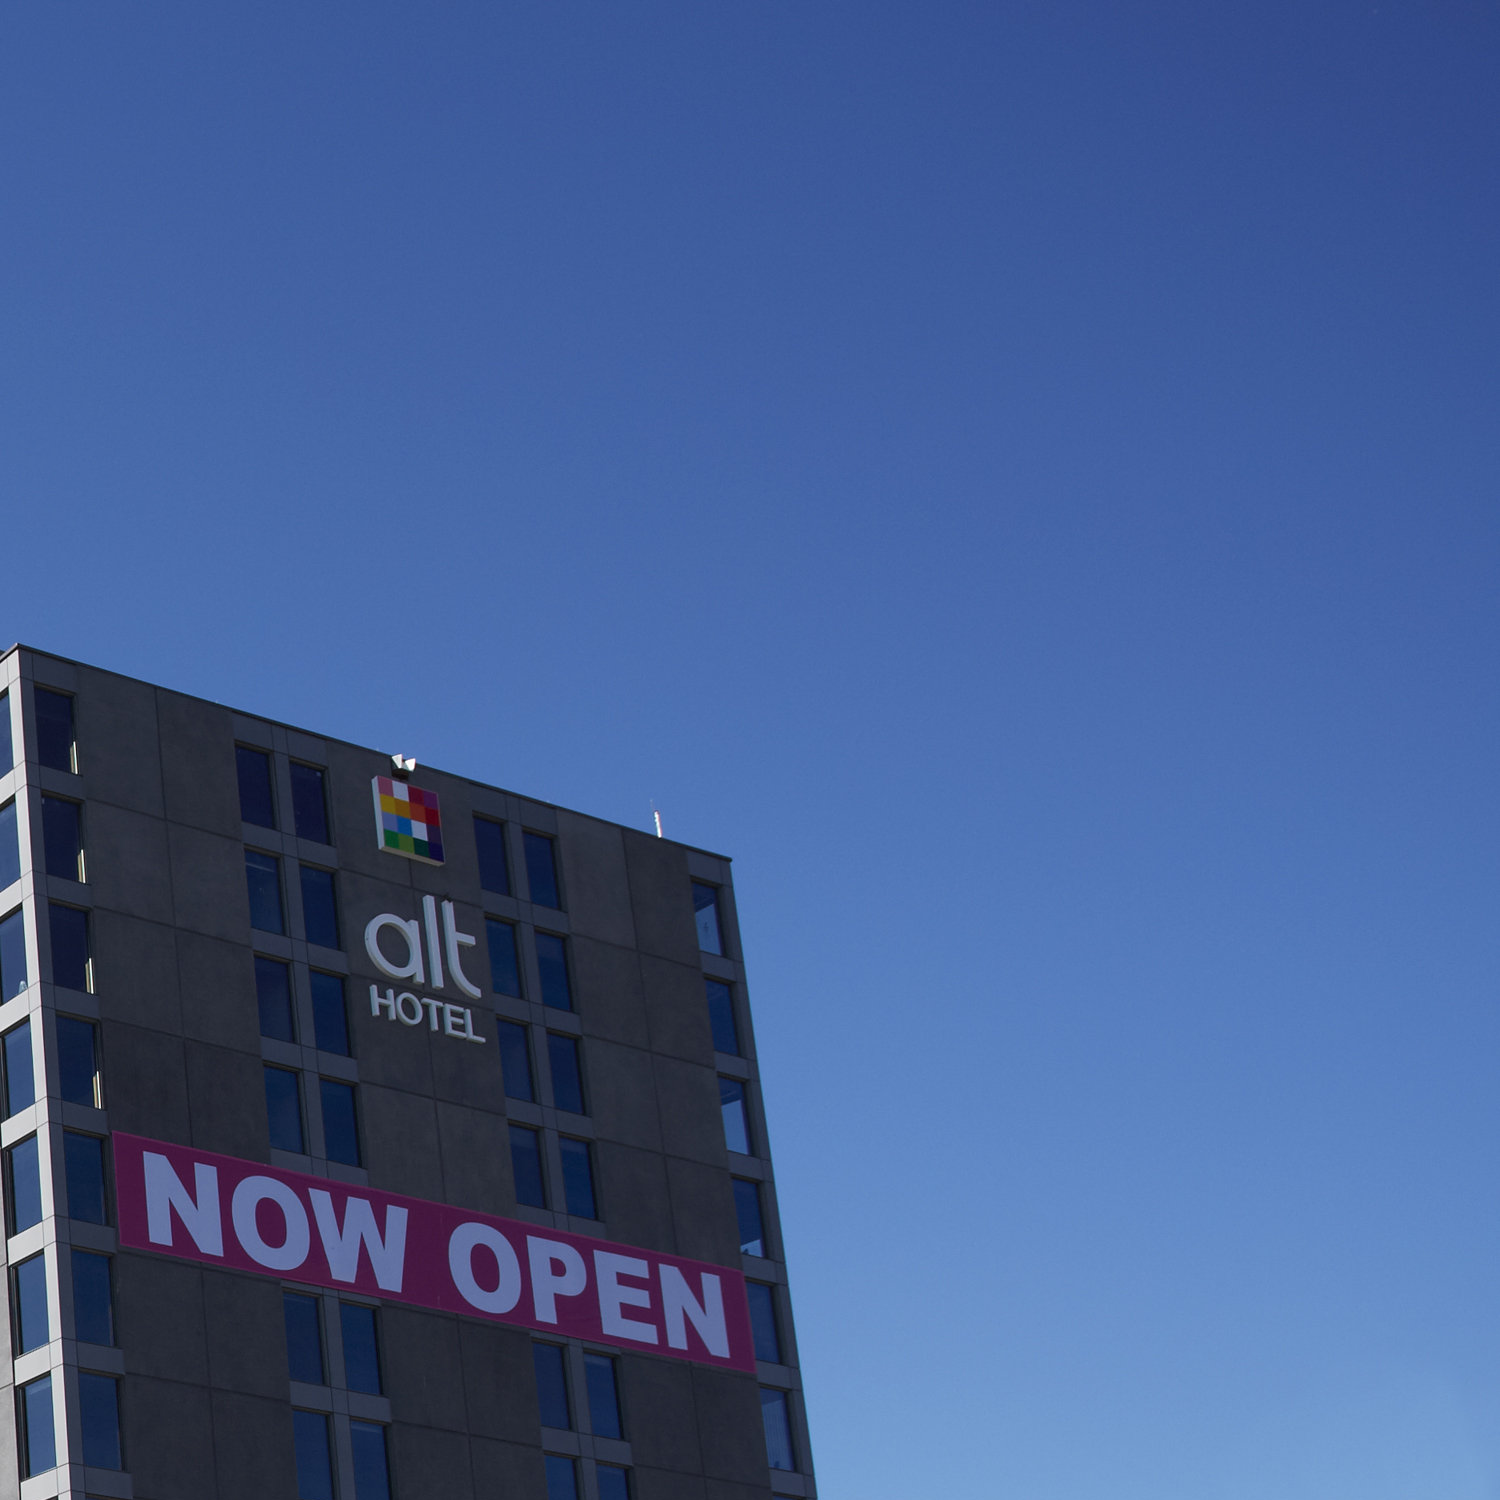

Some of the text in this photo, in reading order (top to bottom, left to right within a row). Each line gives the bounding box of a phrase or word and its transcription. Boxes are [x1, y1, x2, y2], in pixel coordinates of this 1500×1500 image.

[364, 895, 482, 1000] alt
[369, 984, 487, 1044] HOTEL
[142, 1150, 731, 1359] NOW OPEN
